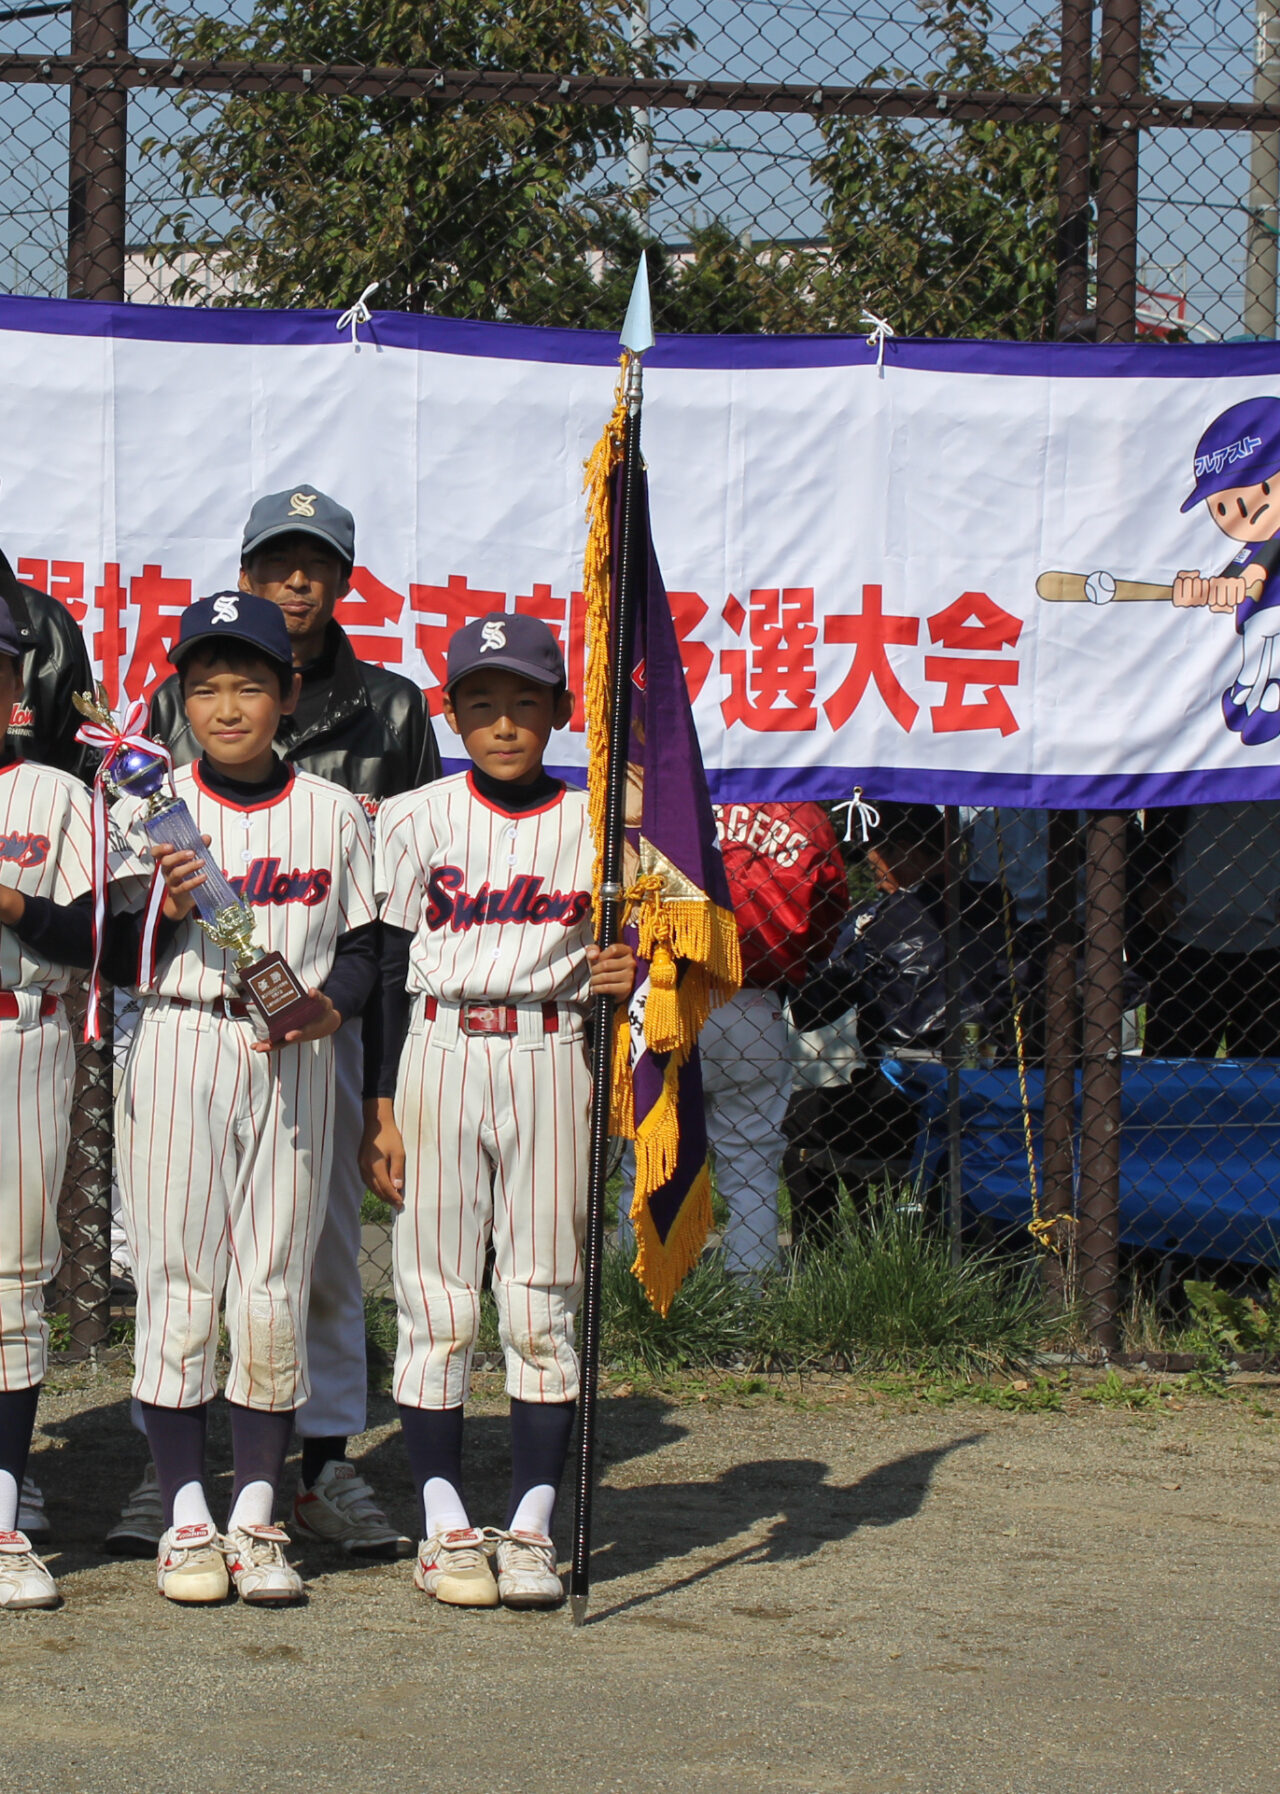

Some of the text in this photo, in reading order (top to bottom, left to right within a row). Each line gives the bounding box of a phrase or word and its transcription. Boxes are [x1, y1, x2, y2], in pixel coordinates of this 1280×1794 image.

[287, 492, 317, 518] S
[211, 595, 238, 625] S
[480, 621, 506, 653] S
[425, 864, 591, 933] Swallows
